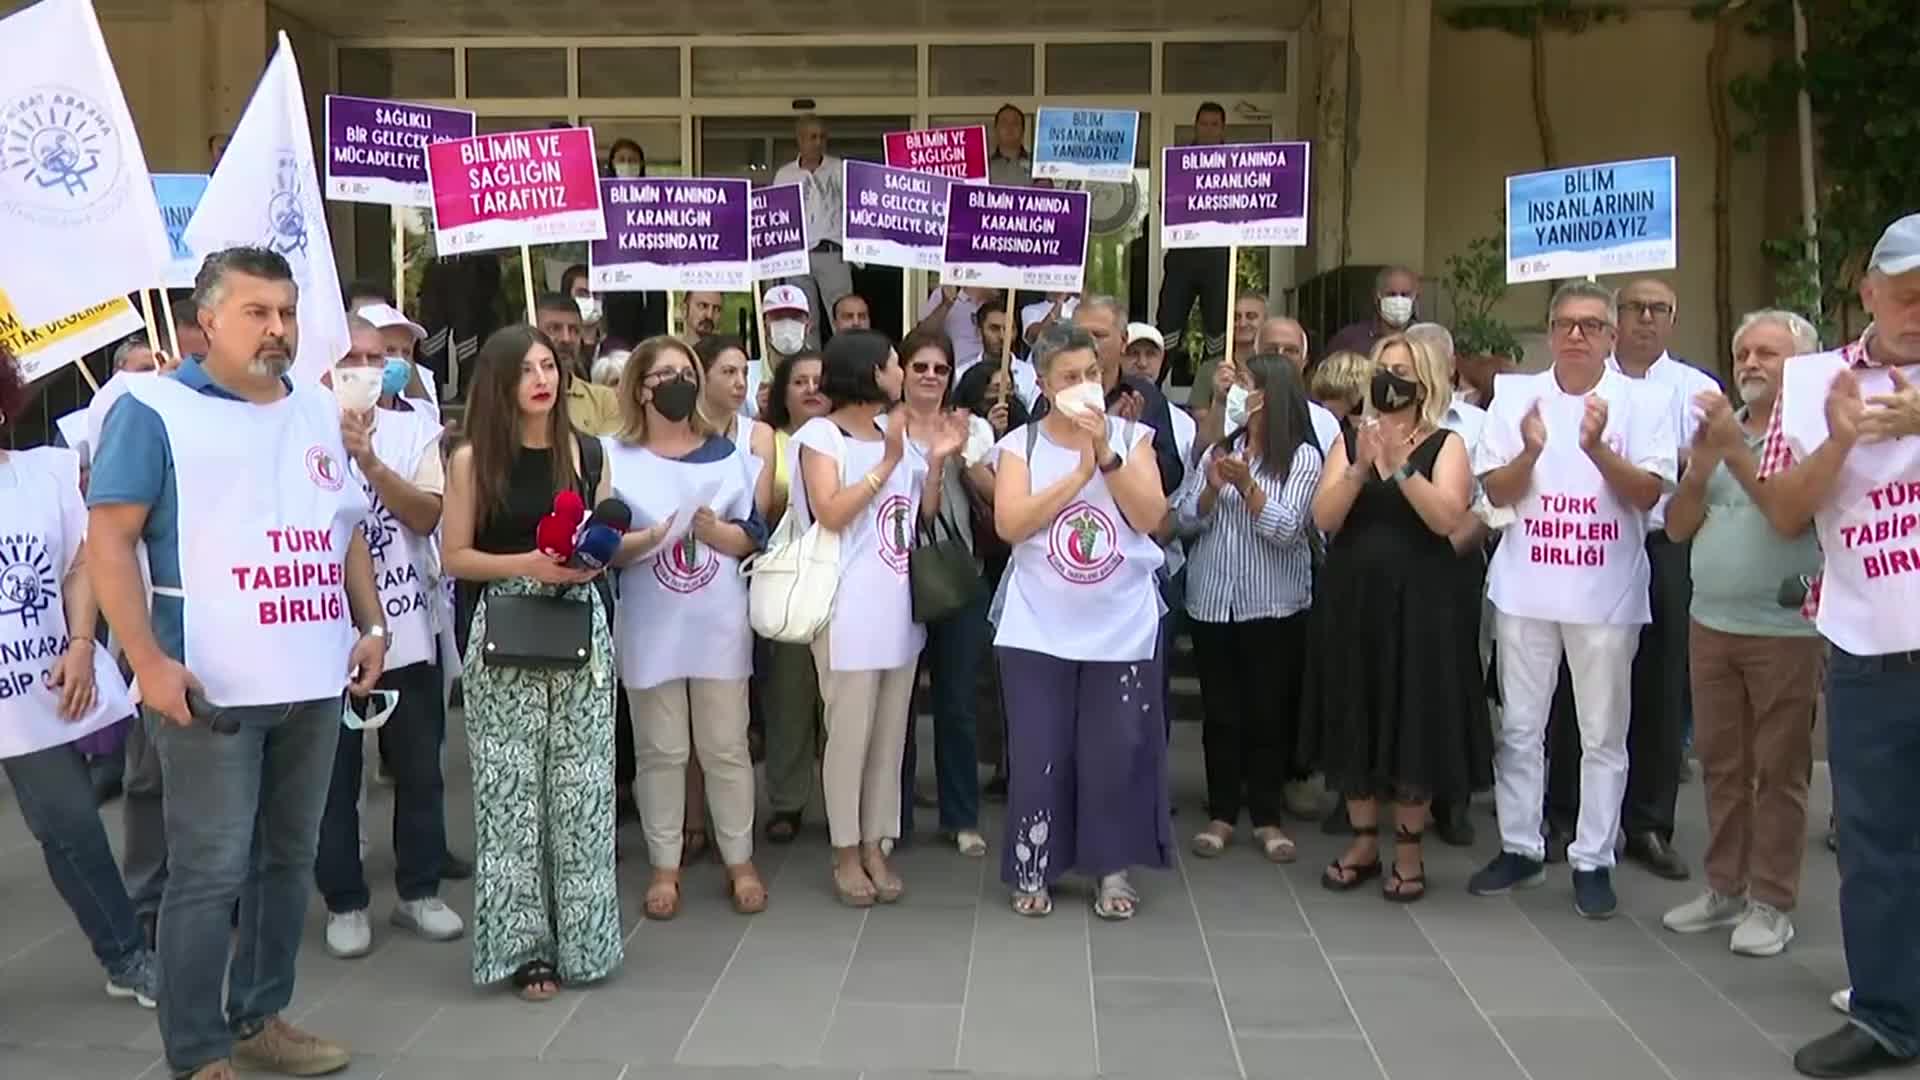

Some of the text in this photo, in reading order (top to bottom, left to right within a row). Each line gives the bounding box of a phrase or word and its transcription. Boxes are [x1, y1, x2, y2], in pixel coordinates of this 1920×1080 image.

[375, 108, 431, 129] SAĞLIKLI
[346, 125, 367, 143] BİR
[372, 129, 428, 149] GELECEK
[906, 130, 966, 150] BİLİMİN VE
[334, 145, 420, 169] MÜCADELEYE
[460, 134, 562, 165] BİLİMİN VE
[910, 146, 966, 165] SAĞLIĞIN
[1052, 143, 1120, 161] YANINDAYIZ
[1182, 151, 1286, 170] BİLİMİN YANINDA
[469, 160, 562, 189] SAĞLIĞIN
[884, 174, 931, 194] SAĞLIKLI
[1195, 170, 1271, 190] KARANLIĞIN
[1564, 168, 1614, 194] BİLİM
[470, 186, 567, 215] TARAFIYIZ
[610, 186, 727, 205] BİLİMİN YANINDA
[860, 189, 879, 206] BİR
[881, 194, 929, 214] GELECEK
[968, 191, 1070, 214] BİLİMİN YANINDA
[1187, 193, 1278, 211] KARŞISINDAYIZ
[1528, 190, 1655, 224] İNSANLARININ
[626, 208, 711, 227] KARANLIĞIN
[850, 209, 946, 236] MÜCADELEYE DEV
[981, 214, 1056, 234] KARANLIĞIN
[618, 233, 720, 251] KARŞISINDAYIZ
[764, 228, 800, 246] DEVAM
[1535, 216, 1648, 246] YANINDAYIZ
[972, 235, 1061, 255] KARŞISINDAYIZ
[0, 329, 44, 352] RTAK
[1541, 492, 1598, 514] TÜRK
[1866, 480, 1920, 510] TÜR
[266, 525, 333, 553] TÜRK
[1524, 518, 1619, 541] TABİPLERİ
[1840, 513, 1920, 548] TABİP
[1530, 544, 1605, 566] BİRLİĞİ
[1863, 547, 1920, 579] BİRL
[0, 635, 69, 664] NKARA
[0, 671, 34, 699] BİP
